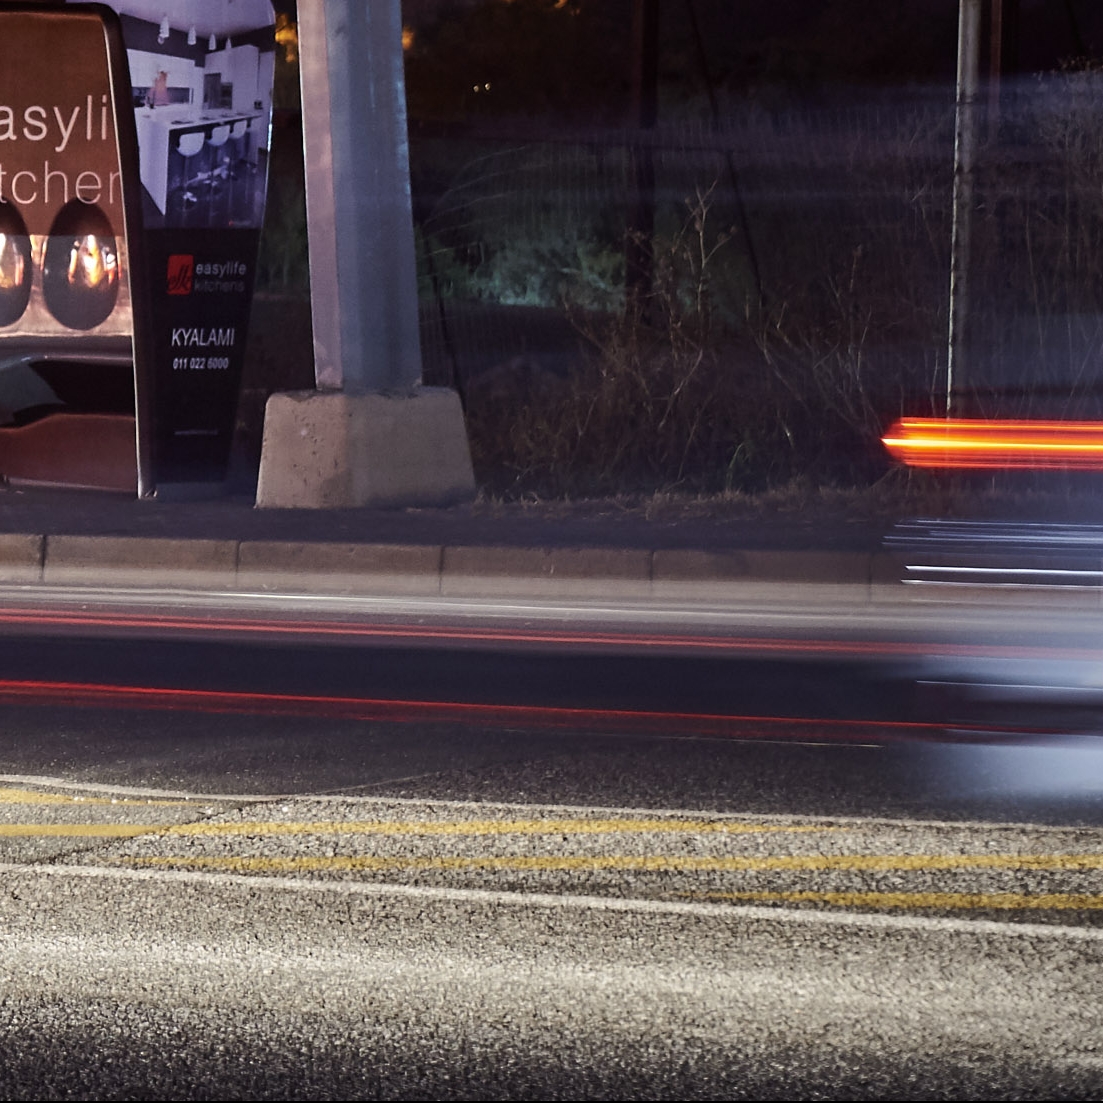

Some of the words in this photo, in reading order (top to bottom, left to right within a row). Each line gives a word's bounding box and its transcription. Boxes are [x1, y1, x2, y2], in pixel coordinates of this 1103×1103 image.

[195, 261, 247, 278] easylife
[171, 328, 235, 346] KYALAMI
[173, 357, 188, 369] 011
[189, 357, 206, 369] 022
